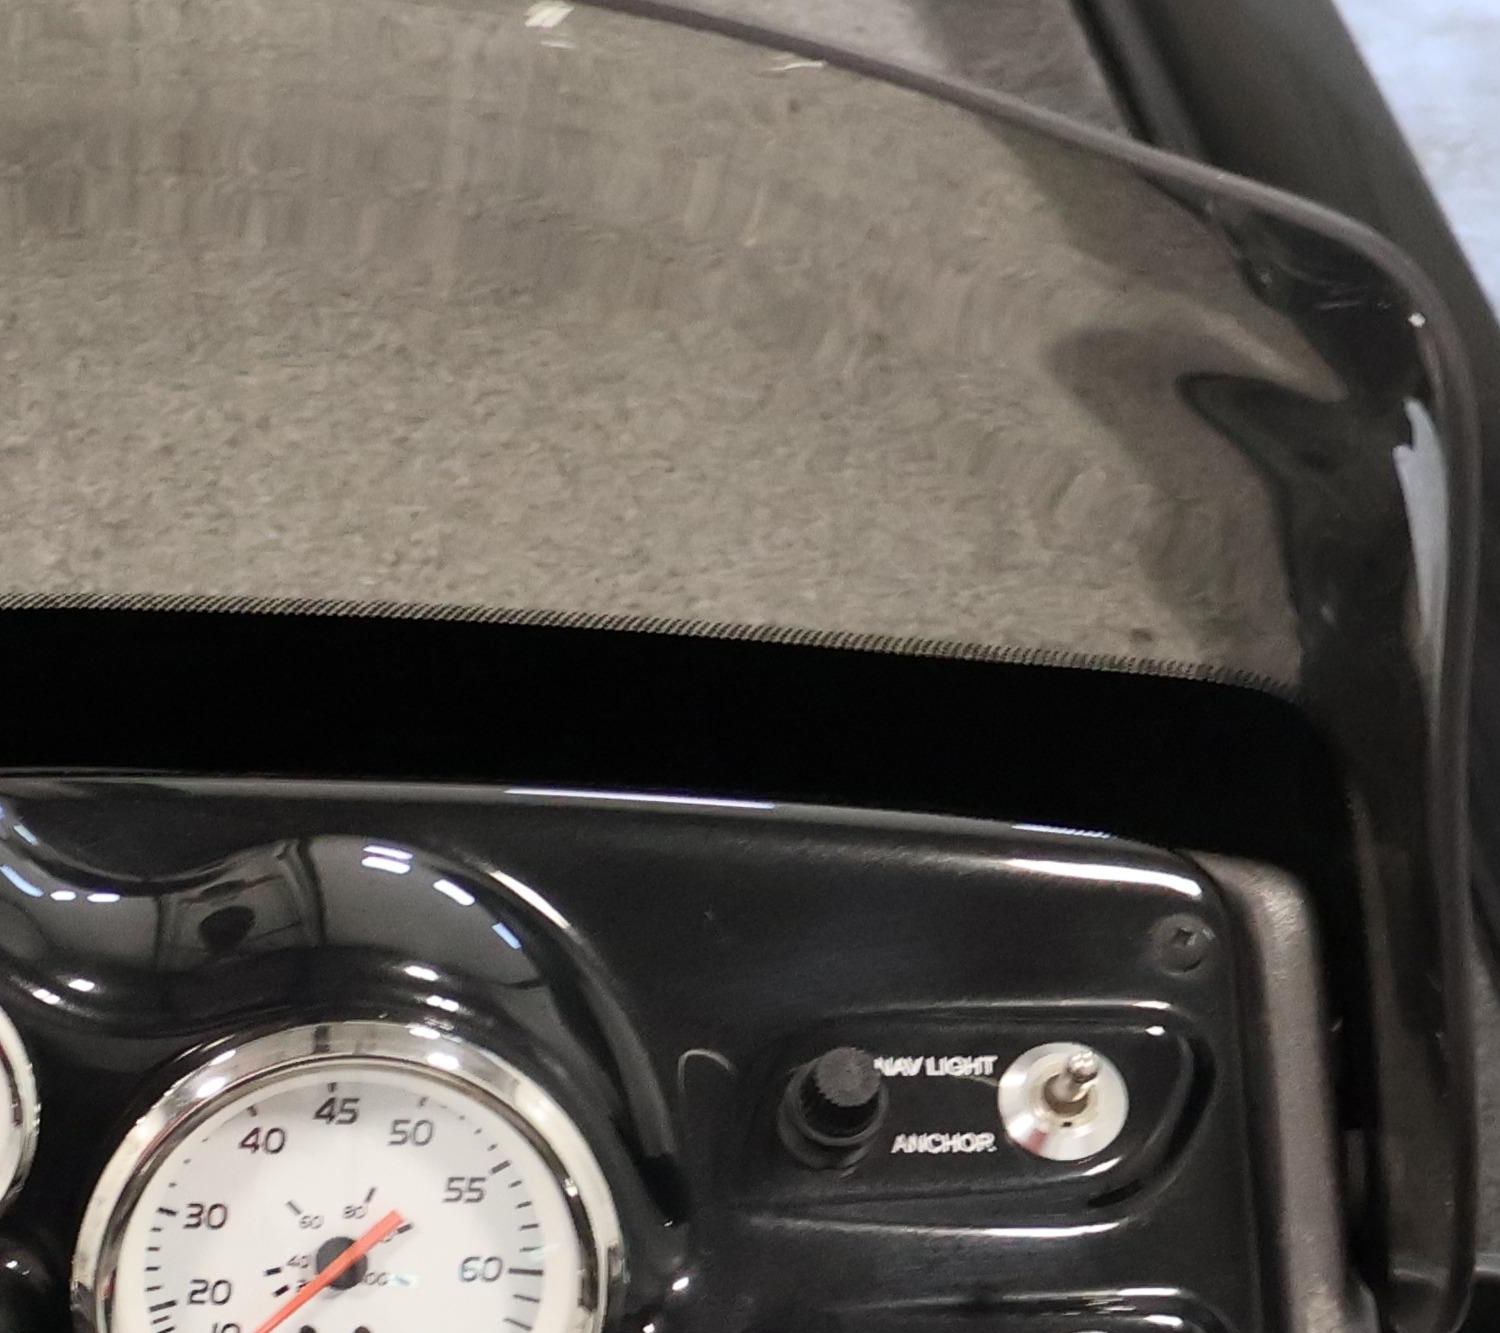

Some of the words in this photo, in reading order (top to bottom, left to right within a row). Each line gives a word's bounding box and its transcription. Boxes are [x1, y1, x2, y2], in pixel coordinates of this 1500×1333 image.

[924, 1055, 998, 1077] LIGHT
[313, 1097, 360, 1126] 45
[239, 1127, 287, 1155] 40
[388, 1118, 435, 1147] 50
[891, 1133, 997, 1154] ANCHOR
[443, 1177, 487, 1204] 55
[184, 1203, 227, 1230] 30
[462, 1256, 504, 1283] 60
[188, 1280, 233, 1306] 20
